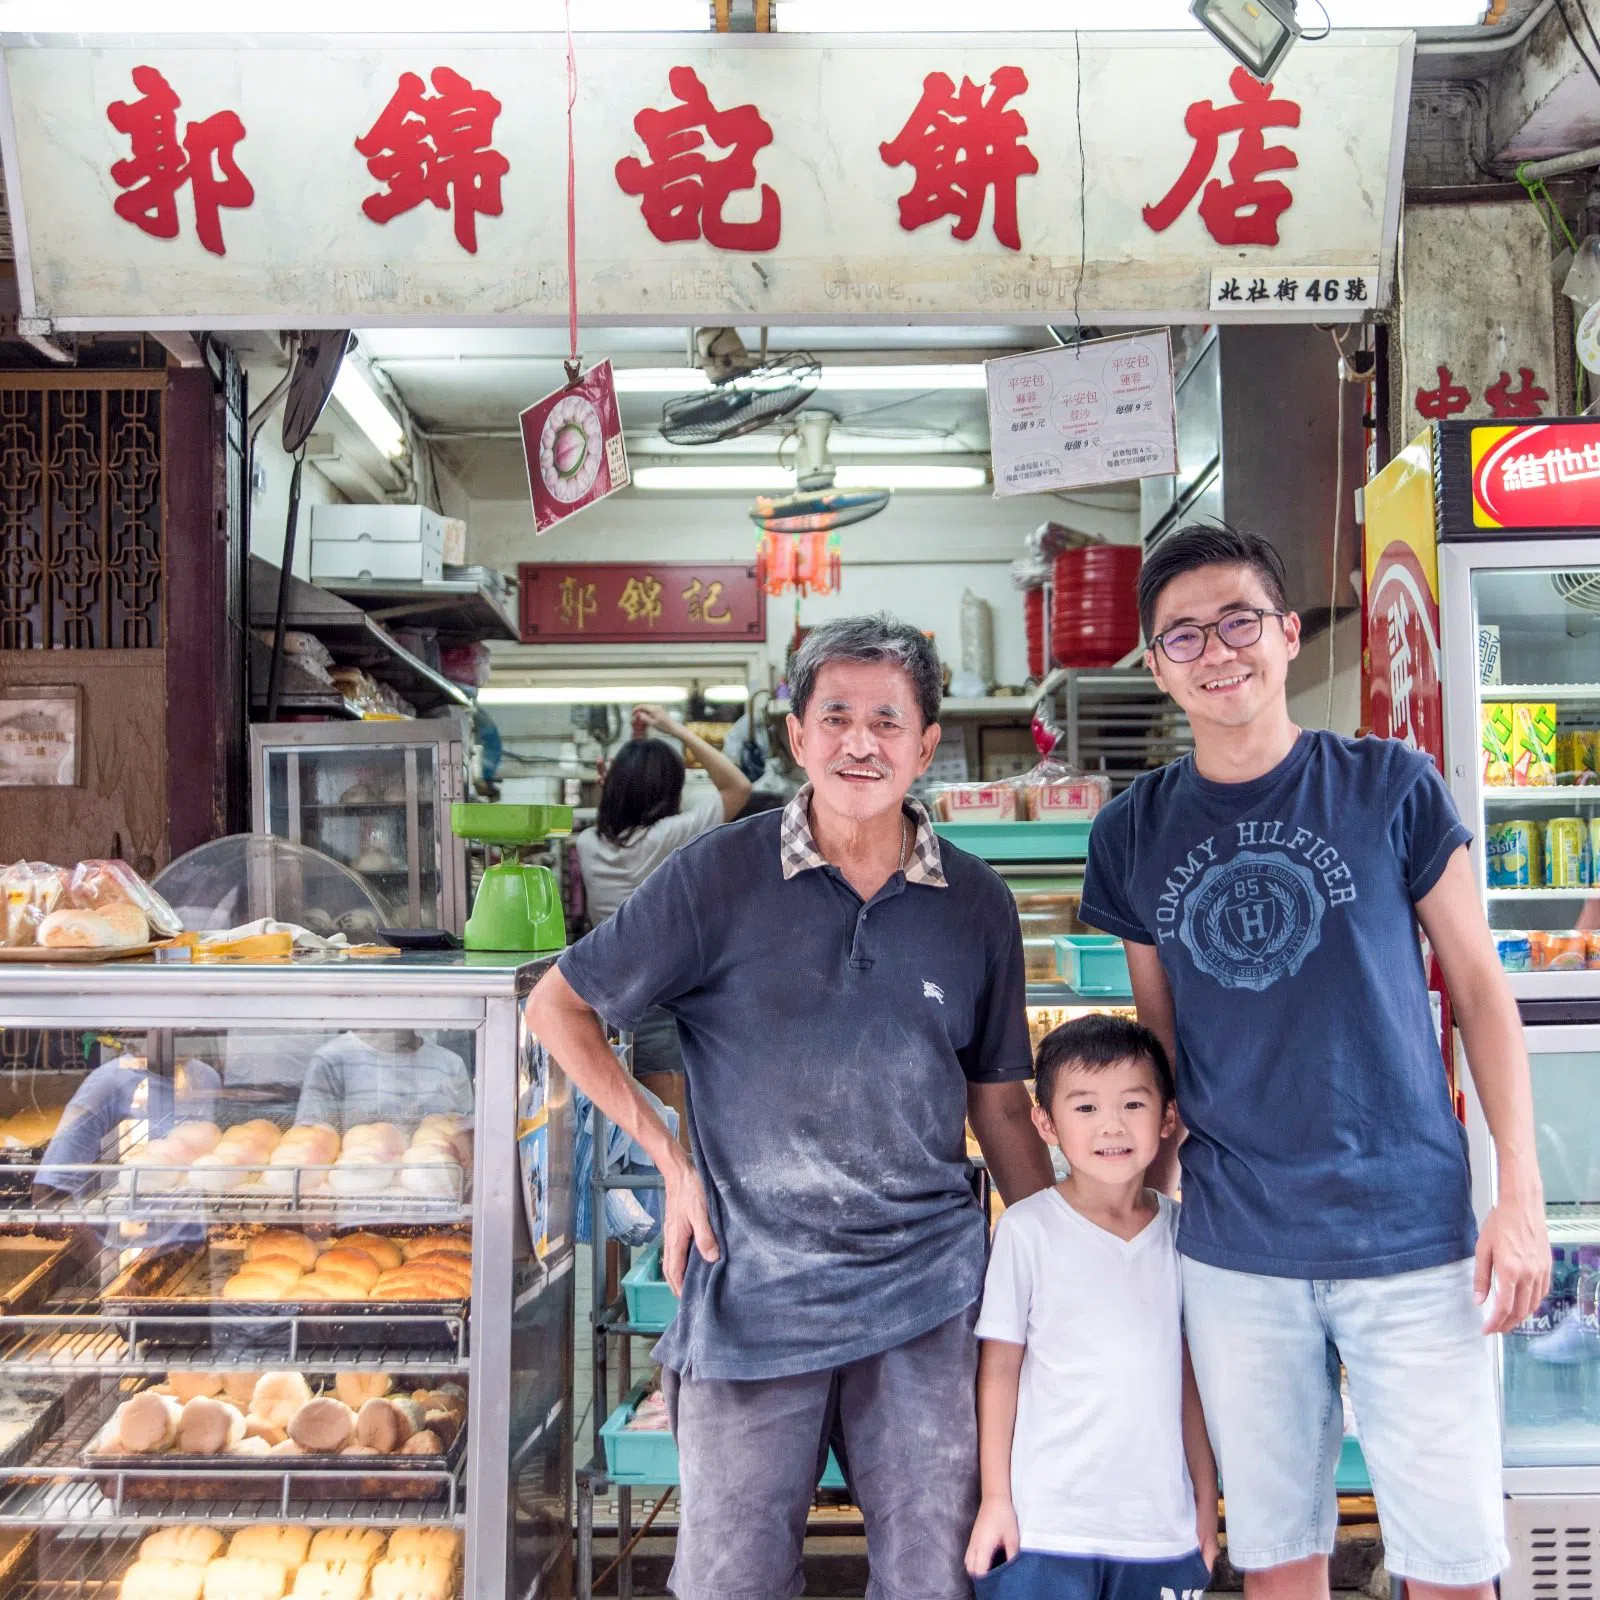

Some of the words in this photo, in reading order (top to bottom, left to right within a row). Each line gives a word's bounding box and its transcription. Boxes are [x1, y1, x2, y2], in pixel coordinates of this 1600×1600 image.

[106, 65, 1302, 257] 郭錦記餅店
[1111, 355, 1150, 372] 平安包
[1007, 374, 1045, 391] 平安包
[1062, 390, 1099, 408] 平安包
[555, 575, 733, 630] 郭錦記
[1156, 836, 1217, 944] TOMMY
[1236, 820, 1357, 908] HILFIGER
[1235, 878, 1260, 898] 85
[1238, 904, 1268, 942] H
